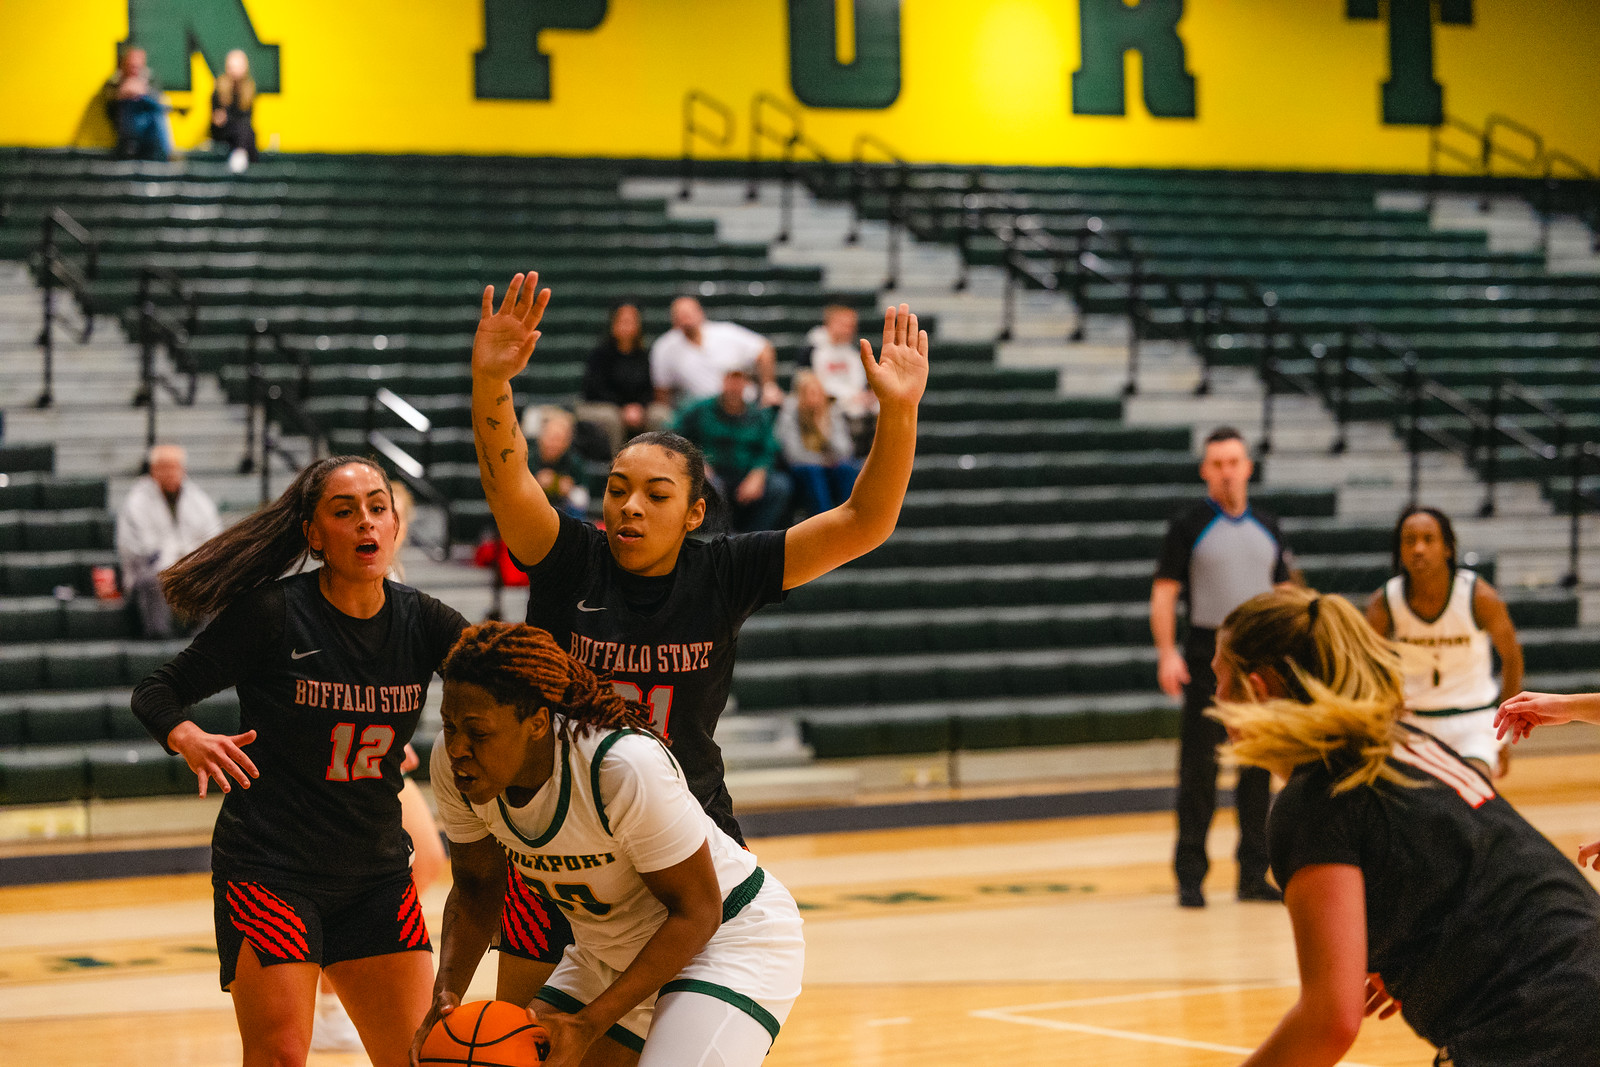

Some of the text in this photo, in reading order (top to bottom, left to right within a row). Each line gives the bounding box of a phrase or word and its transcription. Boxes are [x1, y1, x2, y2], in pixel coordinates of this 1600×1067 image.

[569, 631, 714, 673] BUFFALO STATE
[294, 679, 422, 713] BUFFALO STATE
[325, 722, 396, 782] 12
